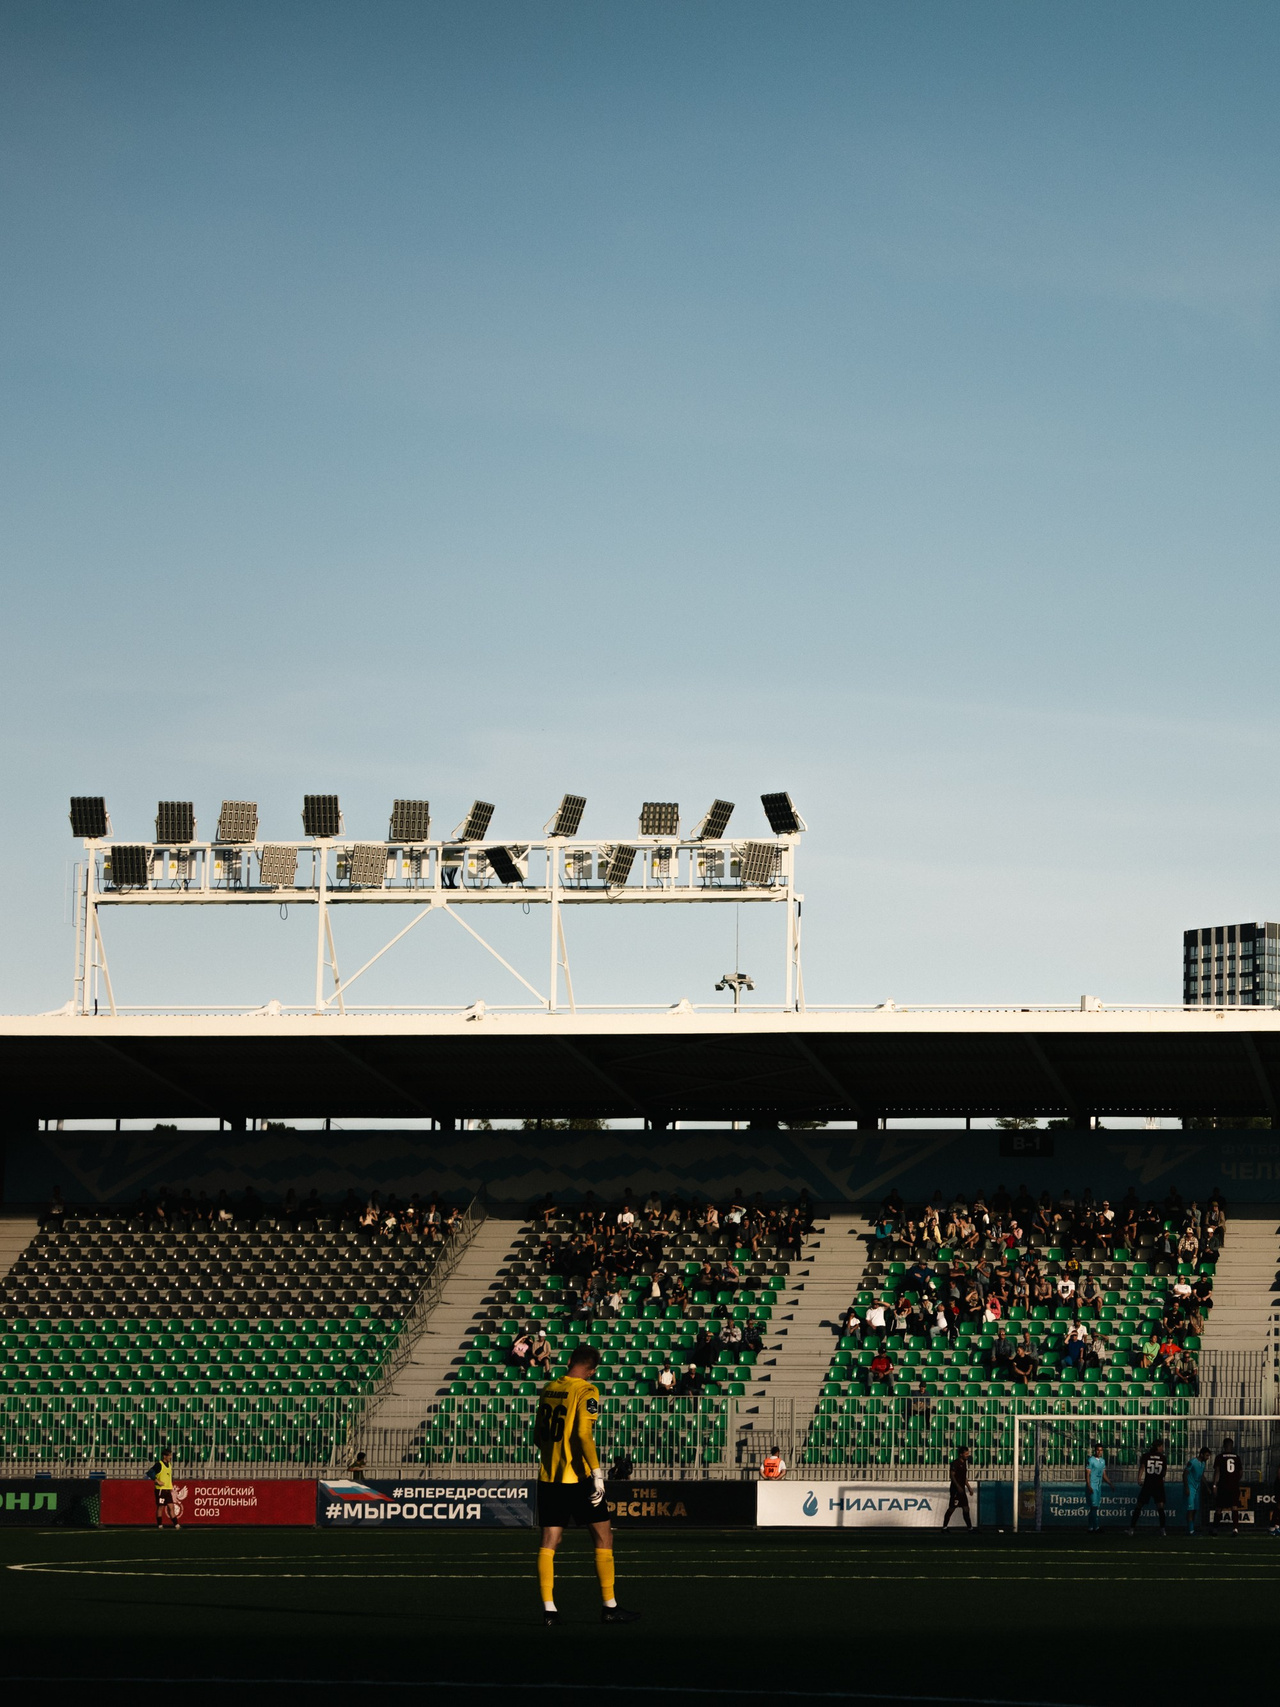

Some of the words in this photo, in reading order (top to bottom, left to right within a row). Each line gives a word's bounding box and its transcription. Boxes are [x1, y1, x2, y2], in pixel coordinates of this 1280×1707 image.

[1146, 1459, 1164, 1475] 55
[1226, 1457, 1235, 1474] 6
[194, 1485, 255, 1496] РОССИЙСКИЙ
[392, 1487, 528, 1500] #ВПЕРЕДРОССИЯ
[632, 1487, 657, 1498] THE
[194, 1496, 258, 1507] ФУТБОЛЬНЫЙ
[829, 1498, 932, 1511] НИАГАРА
[1050, 1494, 1138, 1506] Правильство
[194, 1507, 220, 1517] СОЮЗ
[325, 1503, 481, 1519] #МЫРОССИЯ
